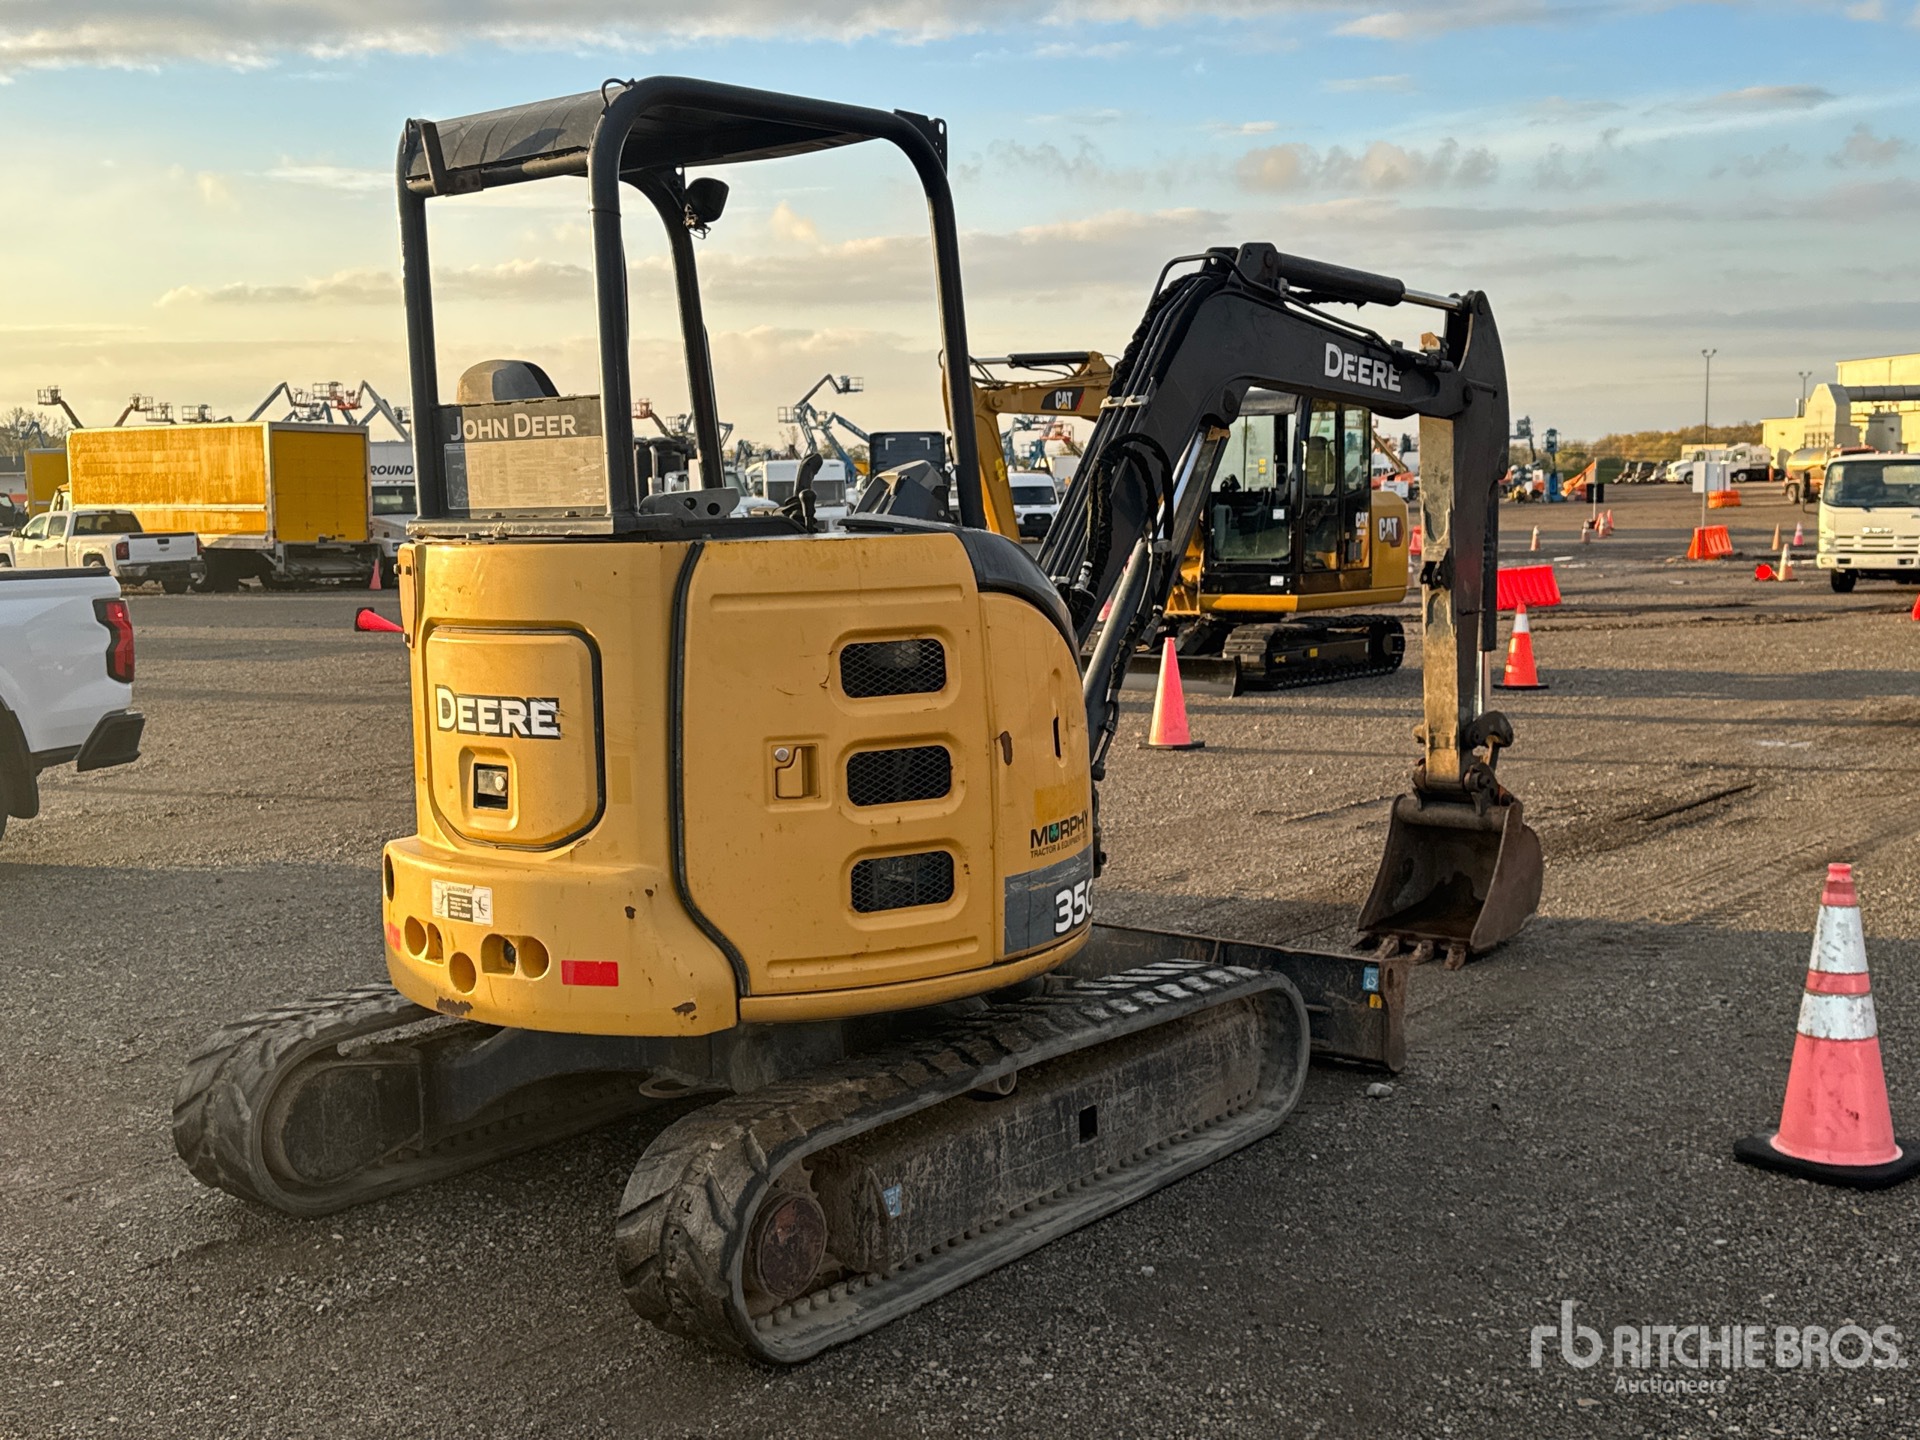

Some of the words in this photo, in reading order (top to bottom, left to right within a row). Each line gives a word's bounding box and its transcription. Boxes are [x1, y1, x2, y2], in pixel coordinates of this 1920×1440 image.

[1324, 342, 1402, 392] DEERE
[1055, 391, 1073, 410] CAT
[450, 416, 508, 441] JOHN
[371, 465, 413, 475] ROUND
[1355, 511, 1369, 528] CAT
[1378, 517, 1398, 541] CAT
[435, 686, 560, 738] DEERE
[1030, 809, 1089, 849] MURPHY
[1030, 845, 1056, 859] TRACTOR
